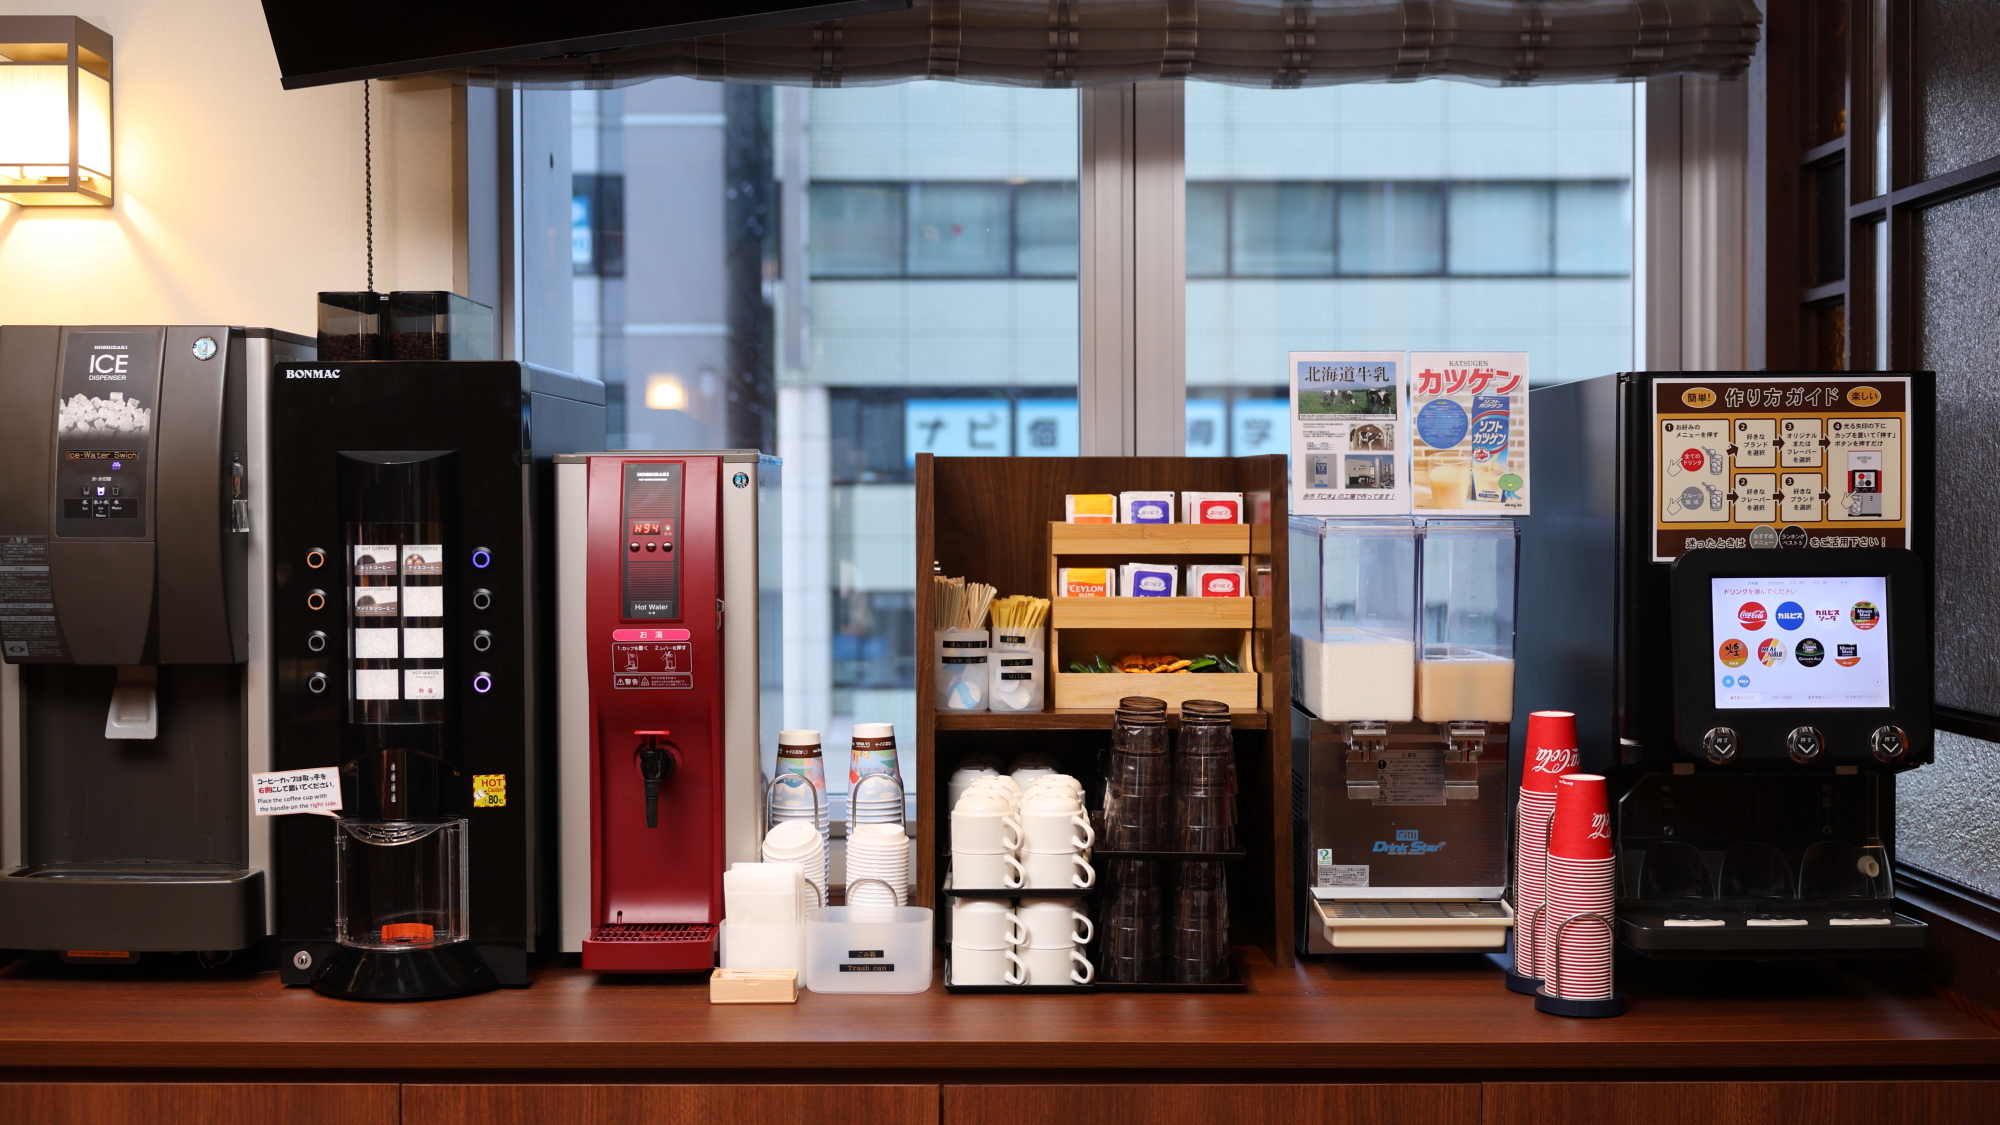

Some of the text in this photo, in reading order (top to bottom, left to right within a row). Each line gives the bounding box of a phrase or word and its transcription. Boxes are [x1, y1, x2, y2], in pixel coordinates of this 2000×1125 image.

[90, 354, 129, 373] ICE
[286, 369, 341, 378] BONMAC
[1304, 366, 1390, 382] 北海道牛乳
[1418, 368, 1521, 395] カツゲン
[1724, 387, 1839, 407] 作り方ガイド
[1852, 392, 1878, 400] 楽しい
[1479, 421, 1503, 433] ソフト
[1473, 433, 1506, 445] カツゲン
[1069, 584, 1104, 592] CEYLON
[257, 773, 326, 785] コーヒーカップは取っ手を
[482, 779, 502, 787] HOT
[1373, 841, 1440, 852] Drink Star
